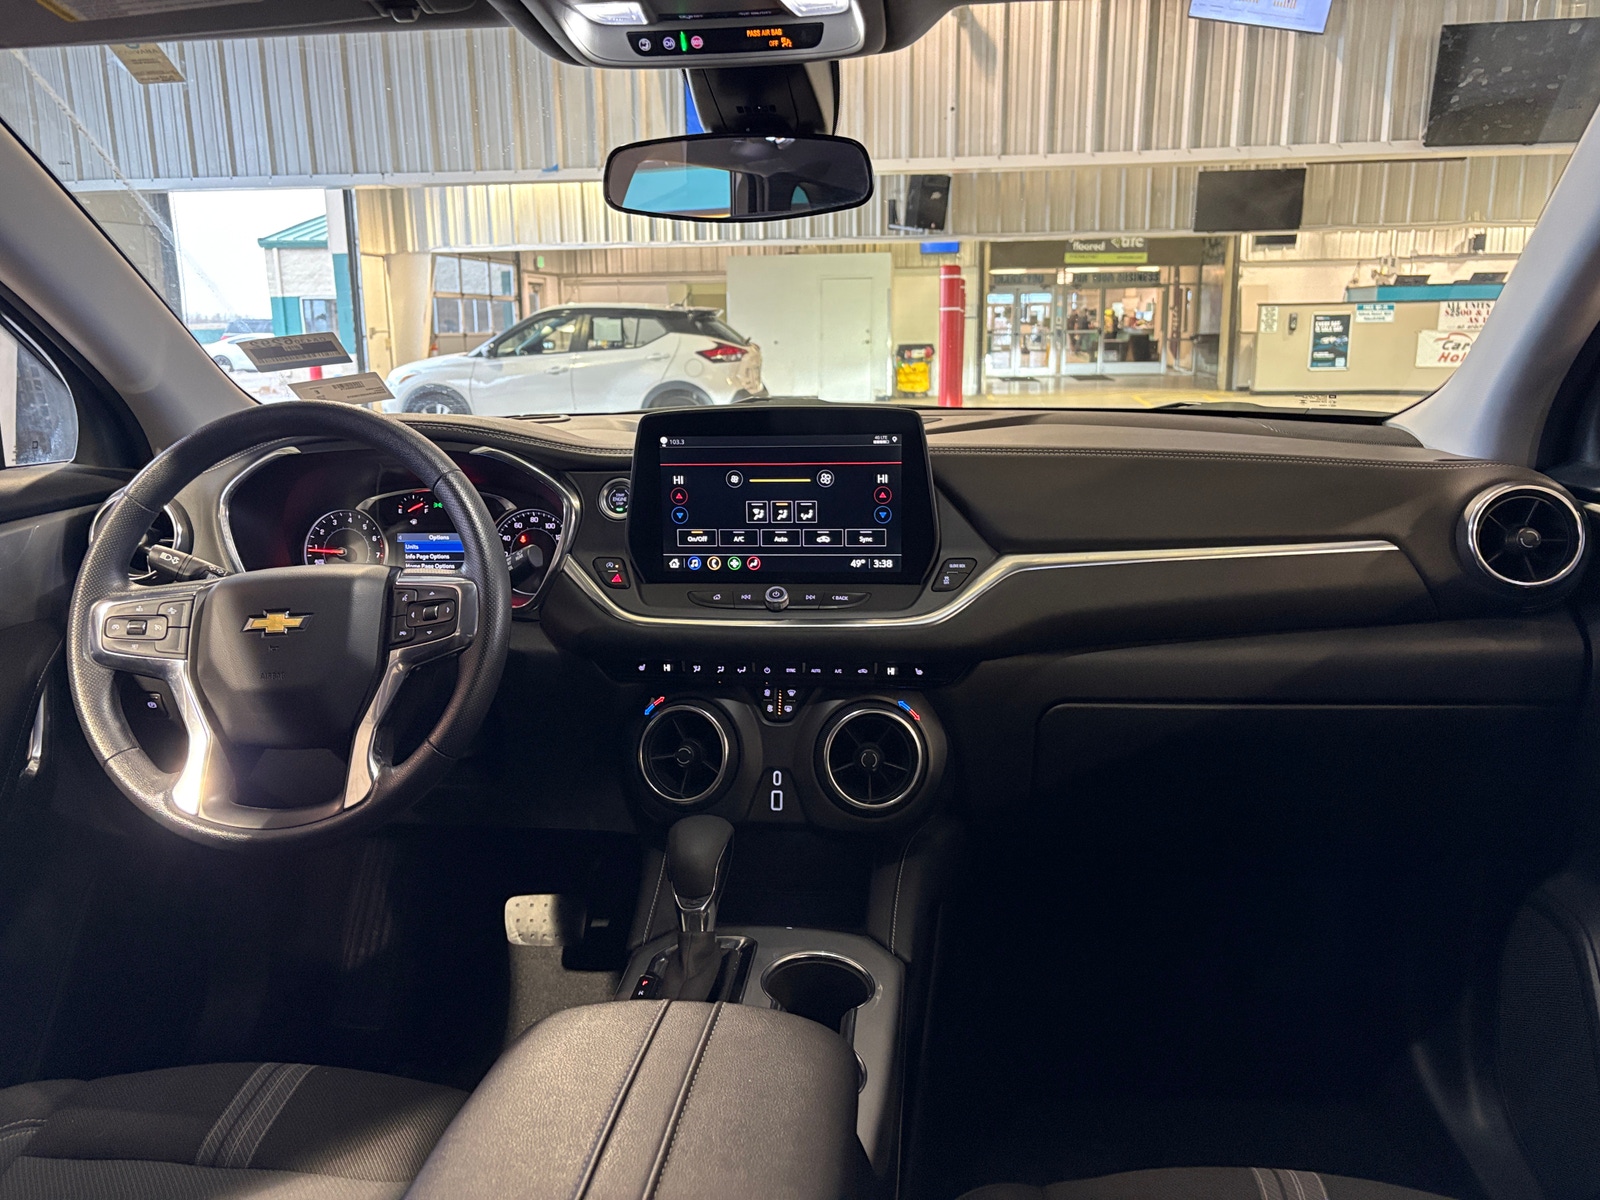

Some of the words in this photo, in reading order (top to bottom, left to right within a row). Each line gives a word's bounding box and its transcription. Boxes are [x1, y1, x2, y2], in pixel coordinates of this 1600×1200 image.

[770, 28, 782, 36] BAG
[1442, 340, 1471, 350] Car
[673, 475, 685, 485] HI
[877, 474, 889, 484] HI
[850, 559, 866, 568] 49°
[873, 559, 893, 568] 3:38
